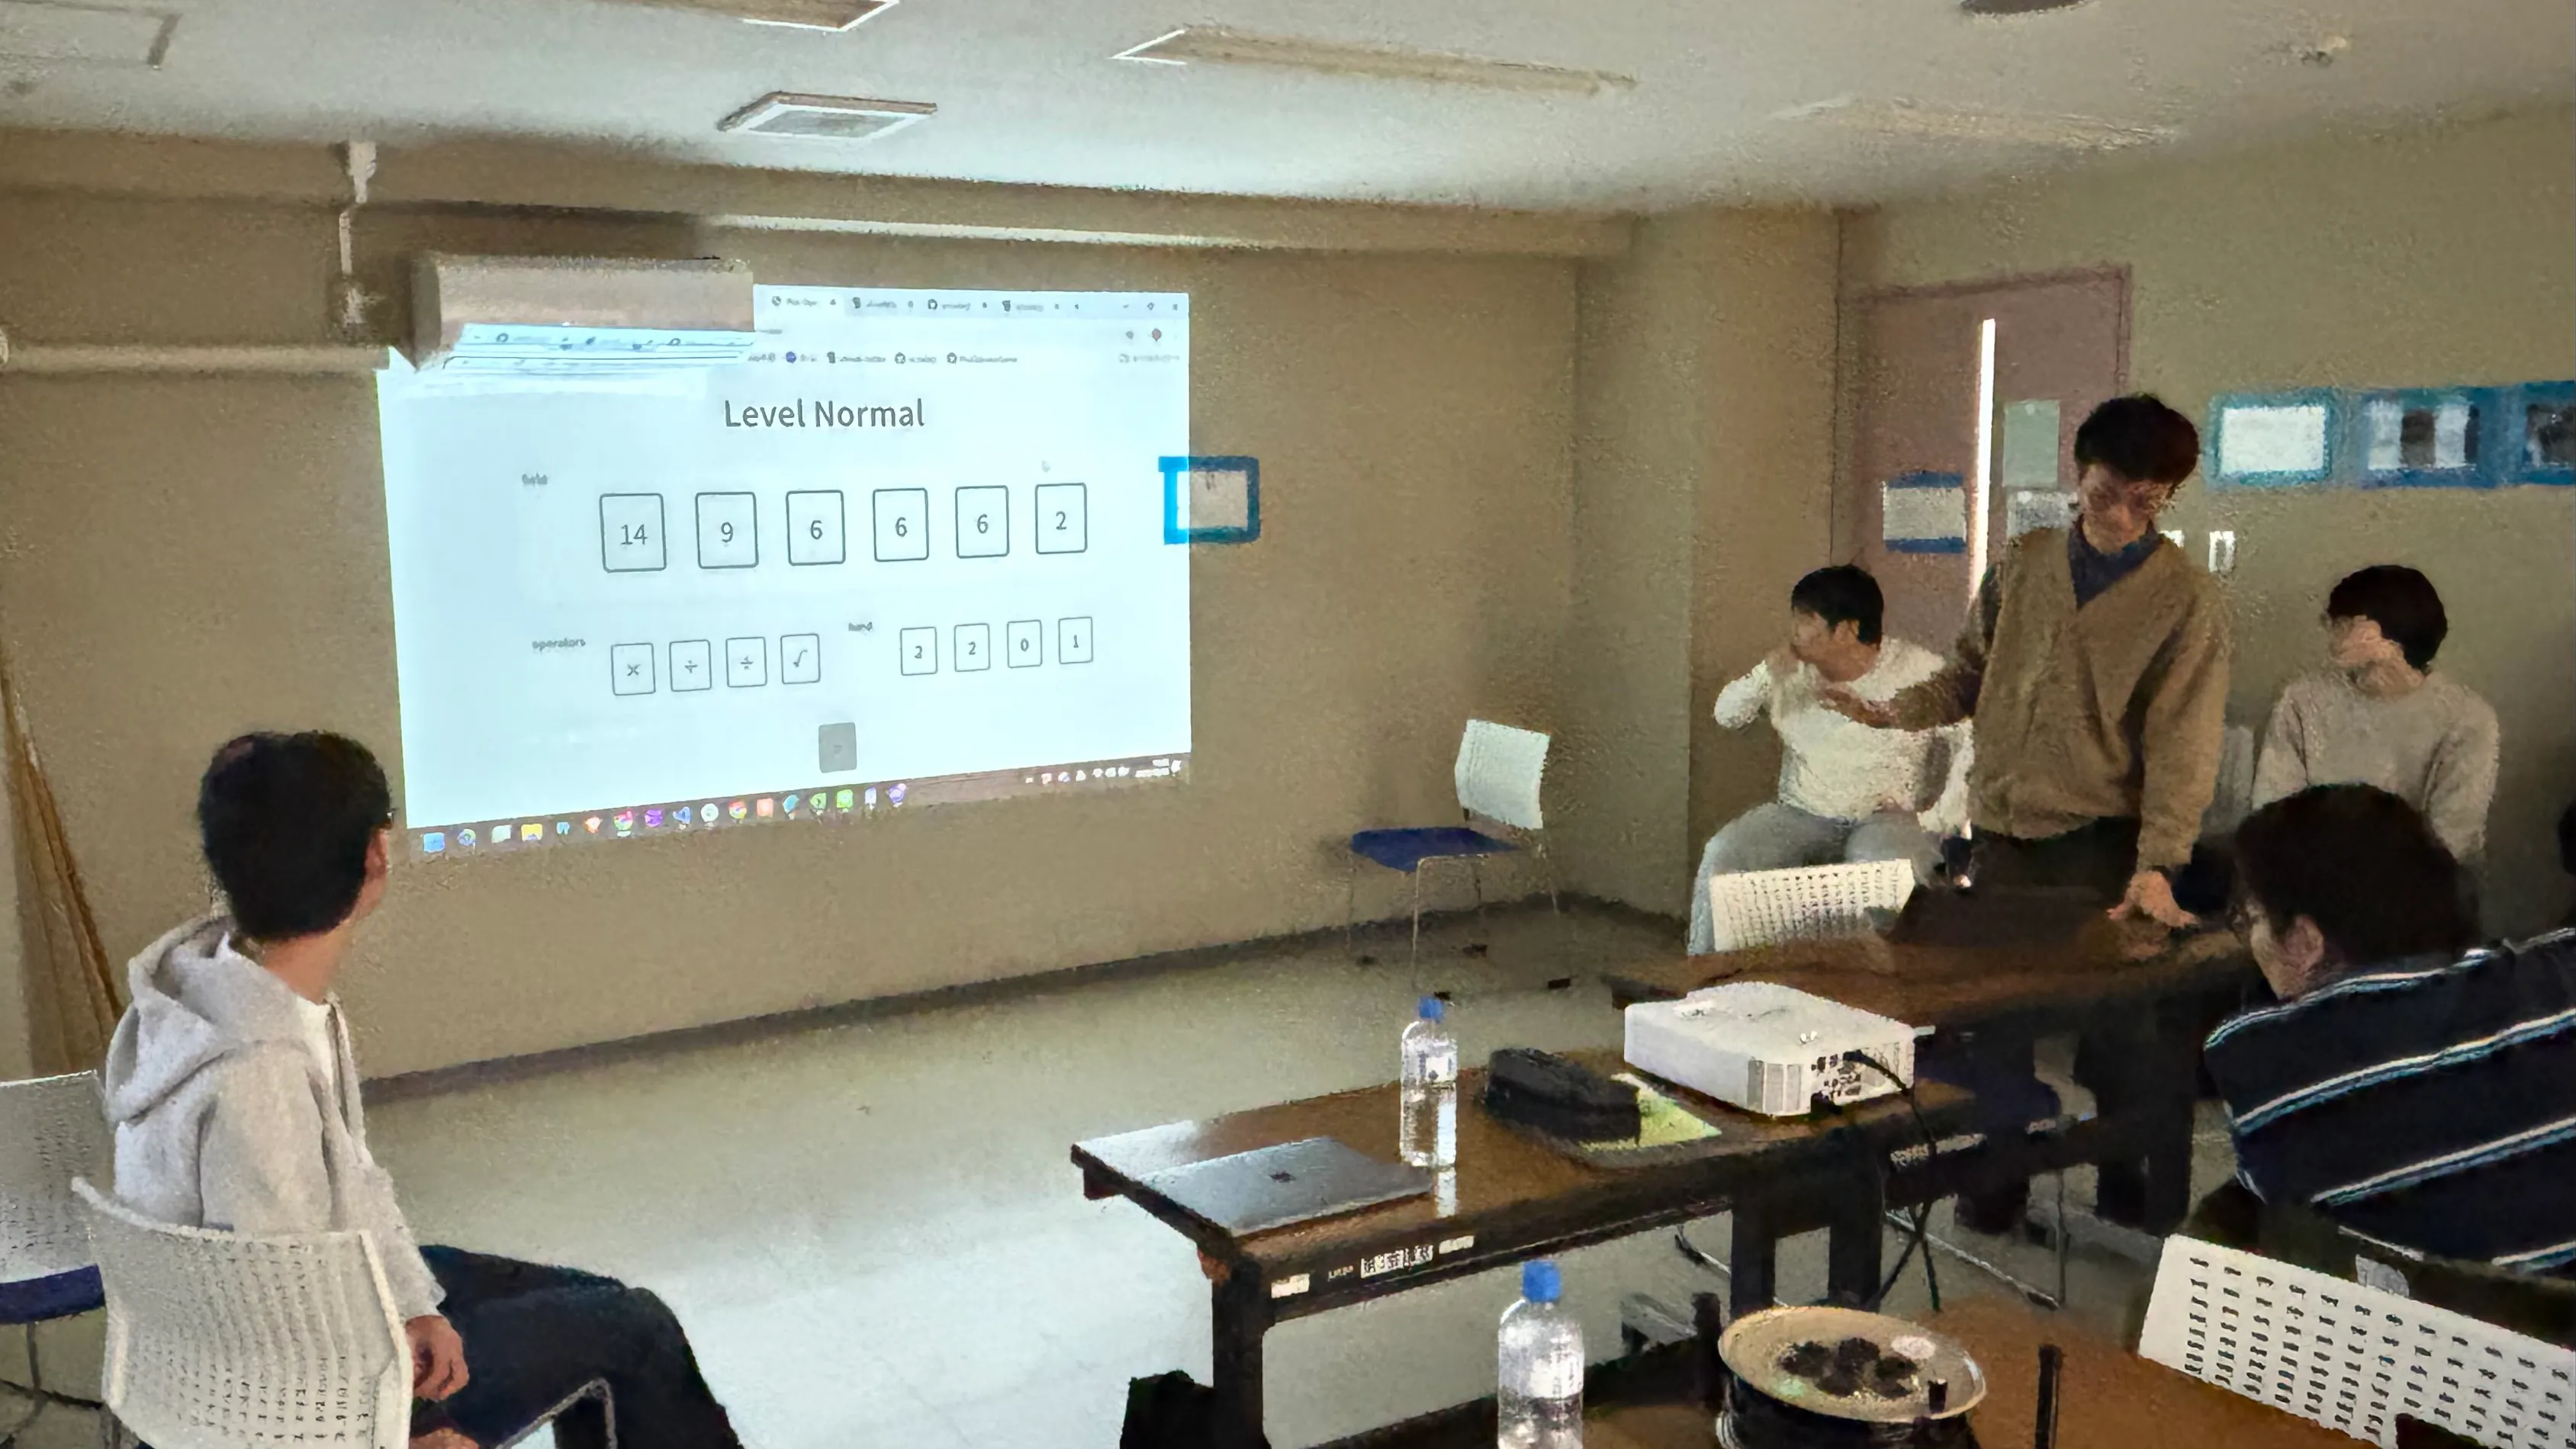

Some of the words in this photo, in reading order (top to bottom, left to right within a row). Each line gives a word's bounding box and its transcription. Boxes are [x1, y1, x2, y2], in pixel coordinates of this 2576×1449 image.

[725, 398, 805, 427] Level
[815, 398, 925, 427] Normal
[620, 524, 648, 545] 14
[721, 522, 734, 543] 9
[810, 519, 823, 540] 6
[896, 517, 908, 538] 6
[977, 514, 989, 535] 6
[1056, 510, 1067, 531] 2
[914, 645, 923, 659] 2
[968, 641, 976, 656] 2
[1020, 638, 1030, 652] 0
[1073, 634, 1079, 648] 1
